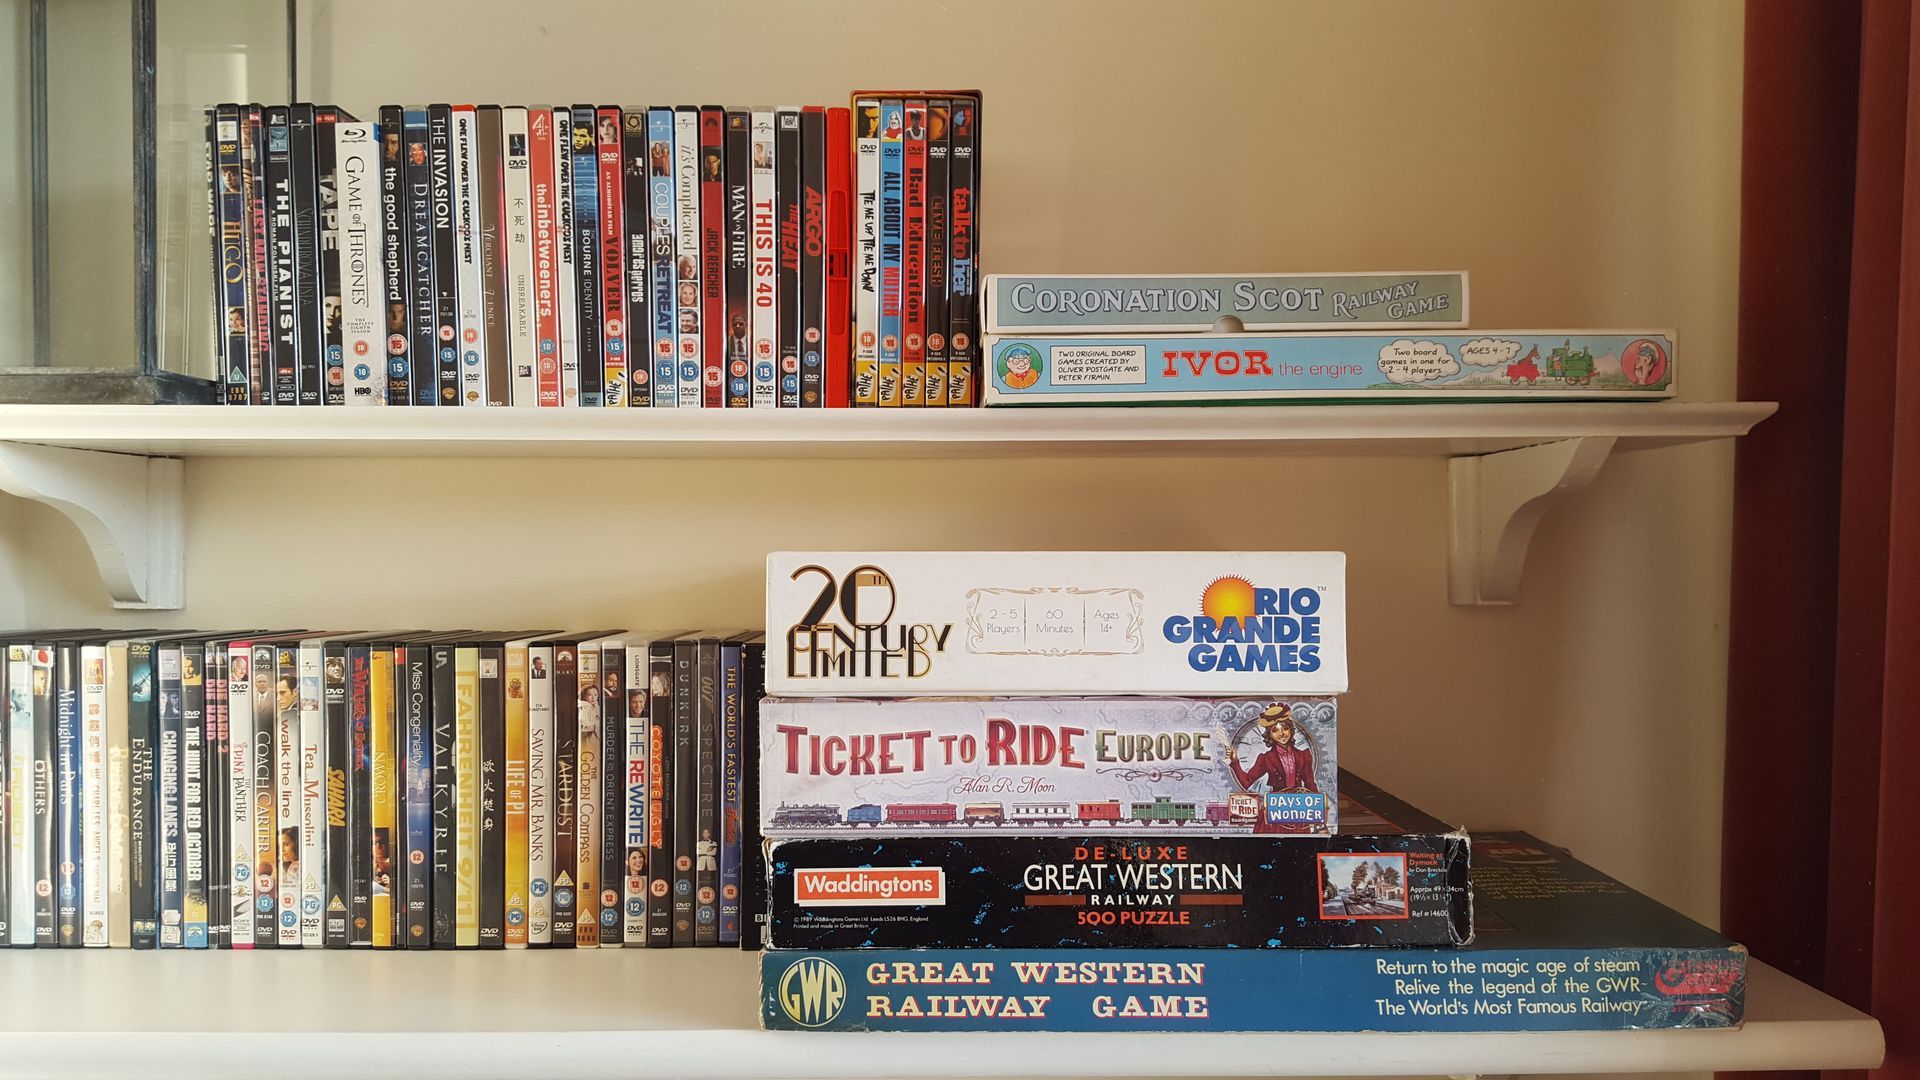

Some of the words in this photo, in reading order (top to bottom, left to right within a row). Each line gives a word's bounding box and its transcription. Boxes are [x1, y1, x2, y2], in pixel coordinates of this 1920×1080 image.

[432, 117, 445, 144] THE
[345, 156, 365, 211] GAME
[385, 167, 397, 191] the
[433, 149, 449, 229] INVASION
[884, 171, 901, 193] ALL
[909, 168, 923, 208] Bad
[276, 179, 290, 227] THE
[384, 194, 399, 230] good
[655, 182, 671, 255] COUPLES
[678, 165, 697, 250] Complicated
[805, 185, 823, 257] ARGO
[884, 197, 901, 239] ABOUT
[755, 199, 773, 250] THIS
[223, 221, 243, 284] HUGO
[348, 223, 369, 308] THRONES
[386, 235, 402, 301] shepherd
[413, 183, 431, 336] DREAMCATCHER
[536, 183, 552, 317] theinbetweeners
[582, 229, 592, 276] BOURNE
[756, 257, 773, 277] IS
[884, 243, 900, 263] MY
[606, 236, 620, 312] VOLVER
[908, 217, 923, 323] Education
[277, 240, 293, 344] PIANIST
[518, 275, 526, 337] UNBREAKABLE
[584, 279, 592, 321] IDENTITY
[656, 259, 672, 334] RETREAT
[756, 282, 773, 308] 40
[882, 266, 900, 317] MOTHER
[1011, 282, 1221, 316] CORONATION
[1233, 281, 1324, 311] SCOT
[1332, 280, 1419, 319] RAILWAY
[1386, 294, 1450, 320] GAME
[1162, 349, 1274, 378] IVOR
[1279, 362, 1304, 376] the
[1309, 363, 1362, 378] engine
[1380, 358, 1407, 367] games
[1438, 357, 1450, 365] for
[1394, 348, 1411, 356] Two
[1413, 348, 1438, 356] board
[1466, 347, 1490, 355] AGES
[1492, 347, 1498, 355] 4
[1388, 366, 1393, 374] 2
[1403, 366, 1408, 374] 4
[1411, 366, 1442, 378] players
[790, 564, 897, 631] 20
[1046, 609, 1063, 619] 60
[1094, 609, 1120, 622] Ages
[1254, 588, 1321, 616] RIO
[786, 623, 955, 653] CENTURY
[987, 623, 1021, 635] Players
[1036, 623, 1074, 633] Minutes
[1163, 615, 1320, 644] GRANDE
[412, 662, 423, 690] Miss
[786, 649, 933, 679] LIMITED
[1188, 644, 1321, 672] GAMES
[58, 689, 76, 748] Midnight
[680, 660, 689, 746] DUNKIRK
[185, 726, 199, 746] THE
[281, 719, 291, 757] walk
[410, 692, 424, 767] Congeniality
[607, 716, 615, 760] MURDER
[630, 721, 644, 755] THE
[777, 724, 931, 776] TICKET
[938, 734, 977, 765] TO
[986, 718, 1085, 769] RIDE
[1096, 729, 1211, 763] EUROPE
[143, 747, 153, 781] THE
[186, 750, 200, 779] HUNT
[233, 749, 245, 774] PINK
[255, 731, 271, 788] COACH
[305, 744, 319, 770] Tea
[457, 684, 472, 850] FAHRENHEIT
[531, 728, 545, 779] SAVING
[652, 727, 662, 799] COYOTE
[701, 723, 713, 817] SPECTRE
[132, 738, 145, 840] ENDURANCE
[281, 760, 291, 786] the
[557, 740, 575, 840] STARDUST
[953, 775, 991, 794] Alan
[992, 777, 1014, 793] R.
[1016, 776, 1056, 794] Moon
[187, 782, 201, 803] FOR
[233, 776, 247, 822] PANTHER
[282, 790, 292, 818] line
[327, 766, 346, 827] SAHARA
[433, 722, 450, 873] VALKYRIE
[531, 784, 544, 811] MR.
[607, 774, 615, 811] ORIENT
[629, 760, 645, 844] REWRITE
[1270, 796, 1301, 807] DAYS
[1305, 796, 1321, 806] OF
[187, 807, 202, 828] RED
[256, 791, 272, 853] CARTER
[304, 779, 319, 847] Mussolini
[652, 802, 662, 848] UGLY
[188, 832, 202, 881] OCTOBER
[531, 815, 544, 861] BANKS
[606, 814, 615, 861] EXPRESS
[1075, 846, 1188, 861] DE-LUXE
[804, 875, 933, 896] Waddingtons
[1023, 863, 1108, 891] GREAT
[1115, 863, 1243, 890] WESTERN
[1077, 911, 1116, 925] 500
[1120, 911, 1190, 925] PUZZLE
[1091, 895, 1175, 906] RAILWAY
[866, 962, 995, 985] GREAT
[1010, 962, 1206, 985] WESTERN
[1376, 958, 1428, 975] Return
[1431, 960, 1448, 974] to
[1451, 957, 1476, 974] the
[1482, 958, 1529, 978] magic
[1536, 961, 1567, 977] age
[1574, 956, 1590, 973] of
[1594, 960, 1640, 973] steam
[780, 960, 845, 1024] GWR
[1375, 999, 1406, 1015] The
[1408, 998, 1469, 1015] World's
[1474, 1000, 1512, 1015] Most
[1517, 998, 1576, 1014] Famous
[1581, 997, 1642, 1016] Railway
[1395, 979, 1440, 995] Relive
[1448, 978, 1474, 994] the
[1482, 978, 1535, 998] legend
[1541, 978, 1557, 994] of
[1564, 977, 1589, 993] the
[866, 995, 1051, 1019] RAILWAY
[1092, 995, 1210, 1019] GAME
